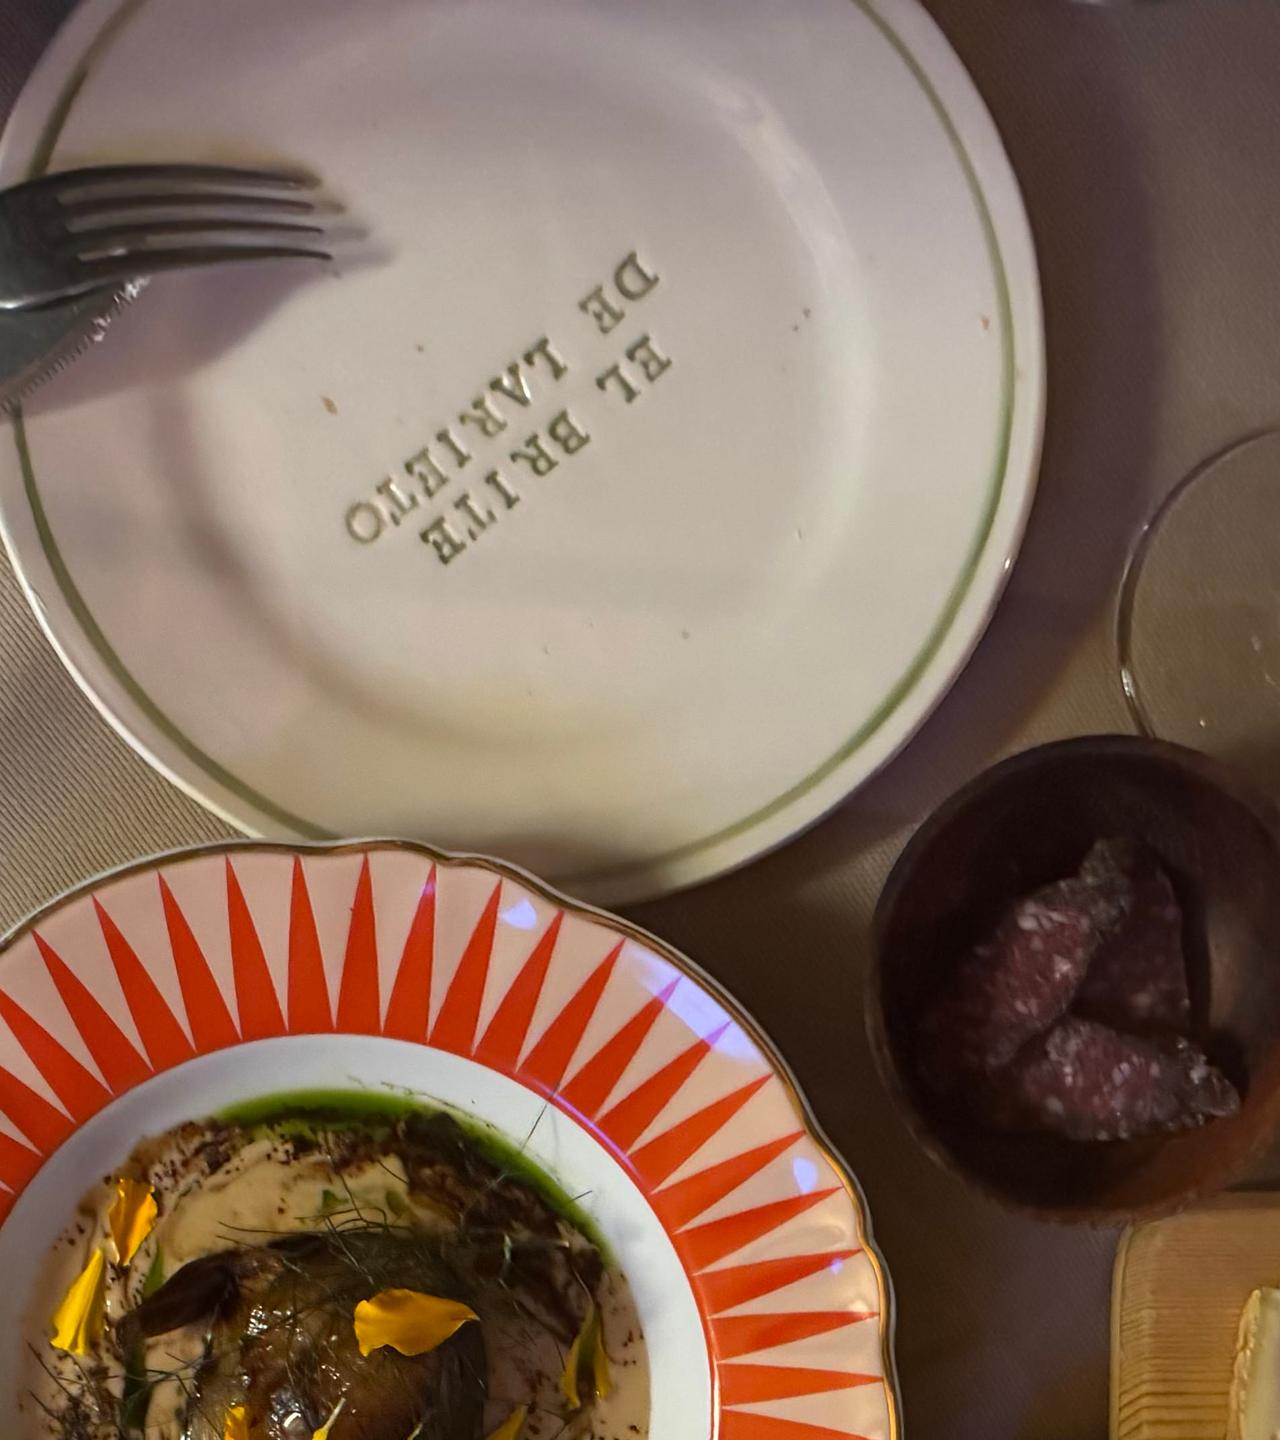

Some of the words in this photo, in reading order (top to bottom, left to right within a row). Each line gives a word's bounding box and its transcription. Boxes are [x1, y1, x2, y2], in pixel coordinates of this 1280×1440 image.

[577, 249, 661, 335] DE
[595, 334, 673, 404] EL
[344, 335, 569, 545] LARIETO
[419, 408, 592, 567] BRITE
